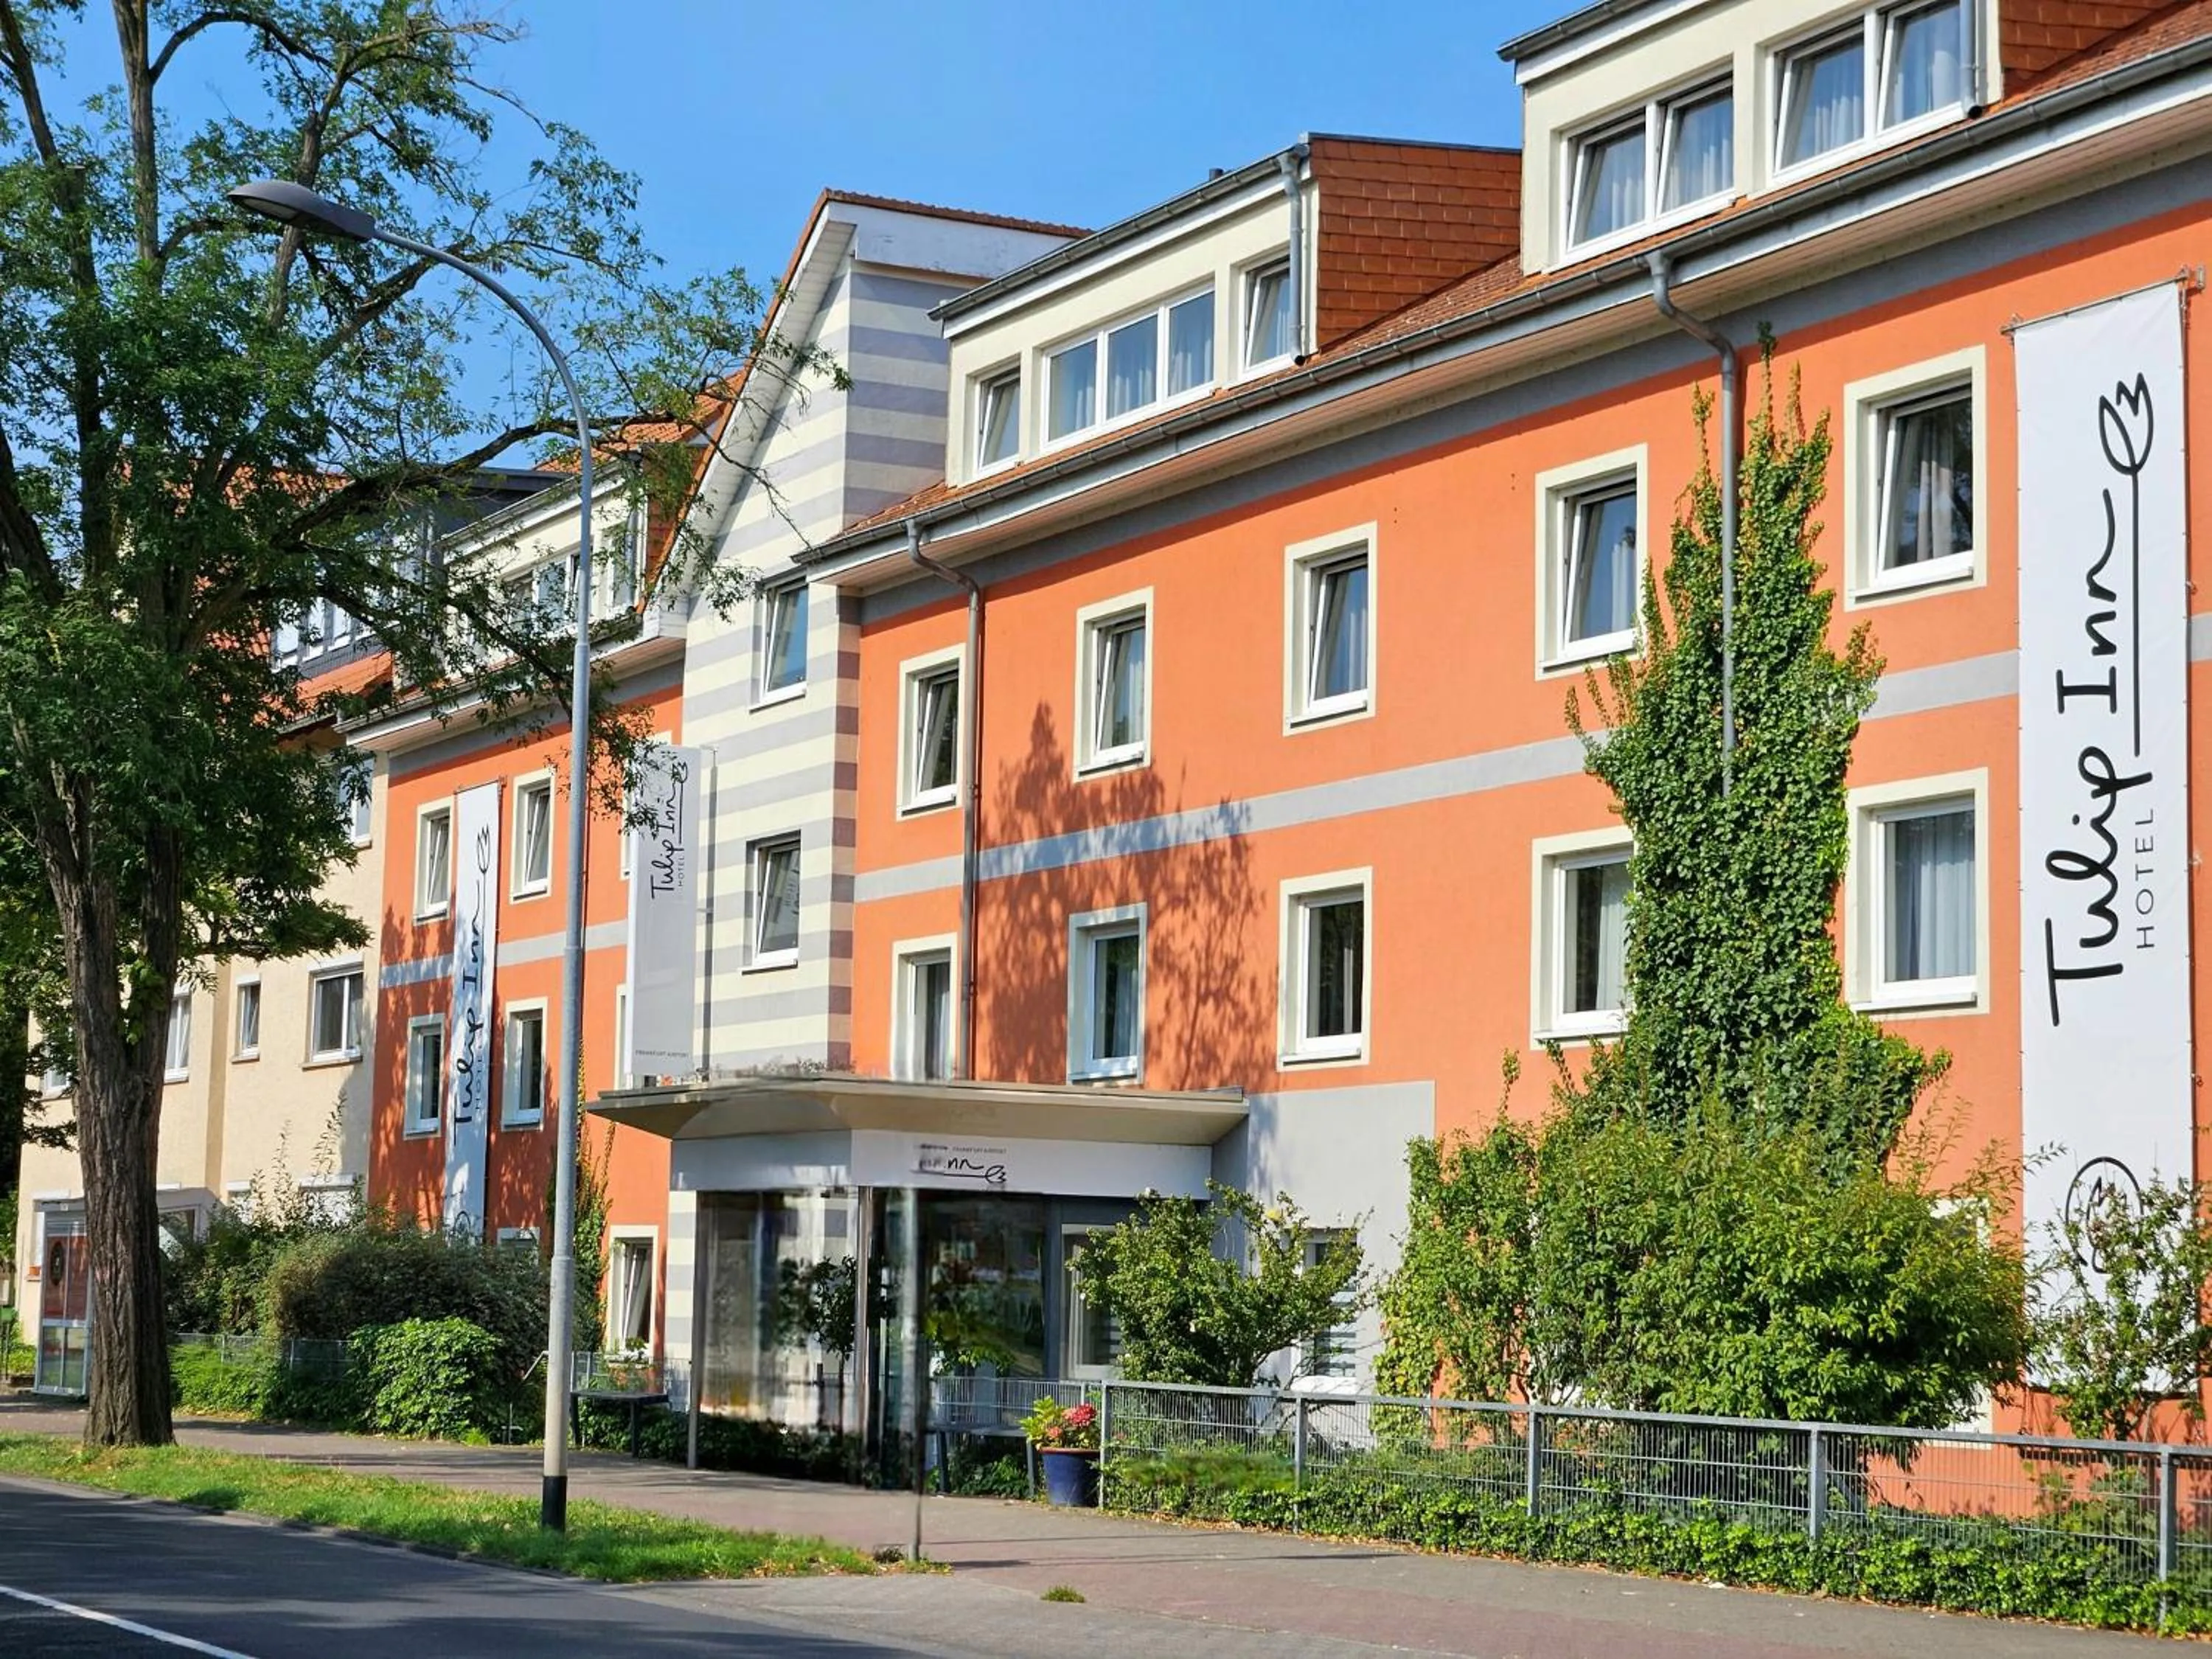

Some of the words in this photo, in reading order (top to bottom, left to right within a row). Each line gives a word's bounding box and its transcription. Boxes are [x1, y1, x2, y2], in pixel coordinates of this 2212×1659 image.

[2056, 487, 2117, 714] Inn
[651, 840, 685, 900] Tulip
[657, 782, 677, 835] Inn
[678, 855, 686, 888] HOTEL
[462, 879, 480, 992] Inn
[2045, 745, 2154, 1026] Tulip
[2135, 808, 2154, 950] HOTEL
[454, 1007, 484, 1147] Tulip
